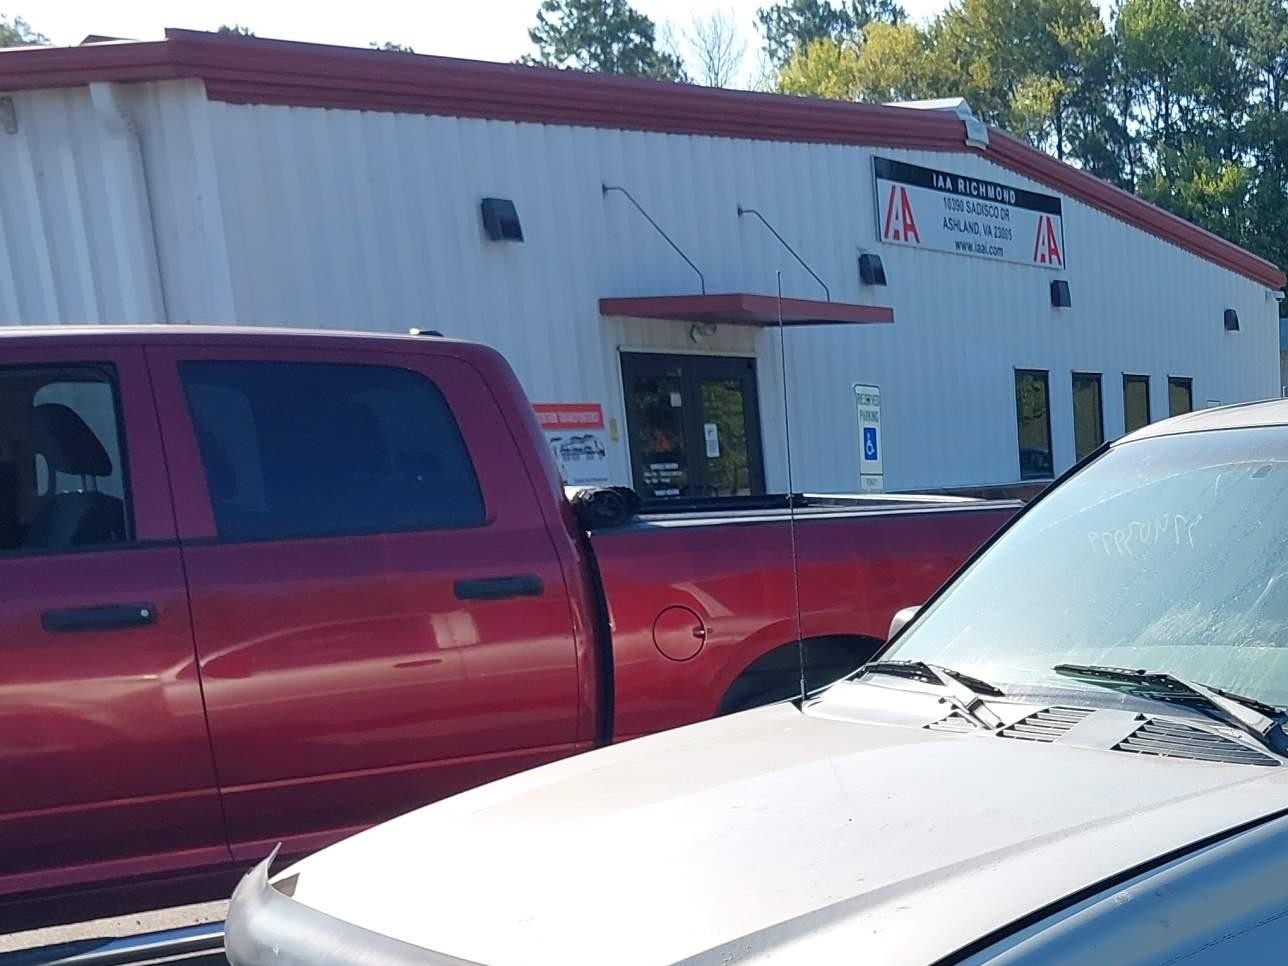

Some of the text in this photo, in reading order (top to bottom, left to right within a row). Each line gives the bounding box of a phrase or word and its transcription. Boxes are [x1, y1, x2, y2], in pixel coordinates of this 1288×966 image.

[931, 173, 1016, 205] IAA RICHMOND
[965, 200, 1000, 220] SADISCO
[1000, 207, 1010, 222] DR
[942, 215, 982, 238] ASHLAND,
[982, 222, 994, 239] VA
